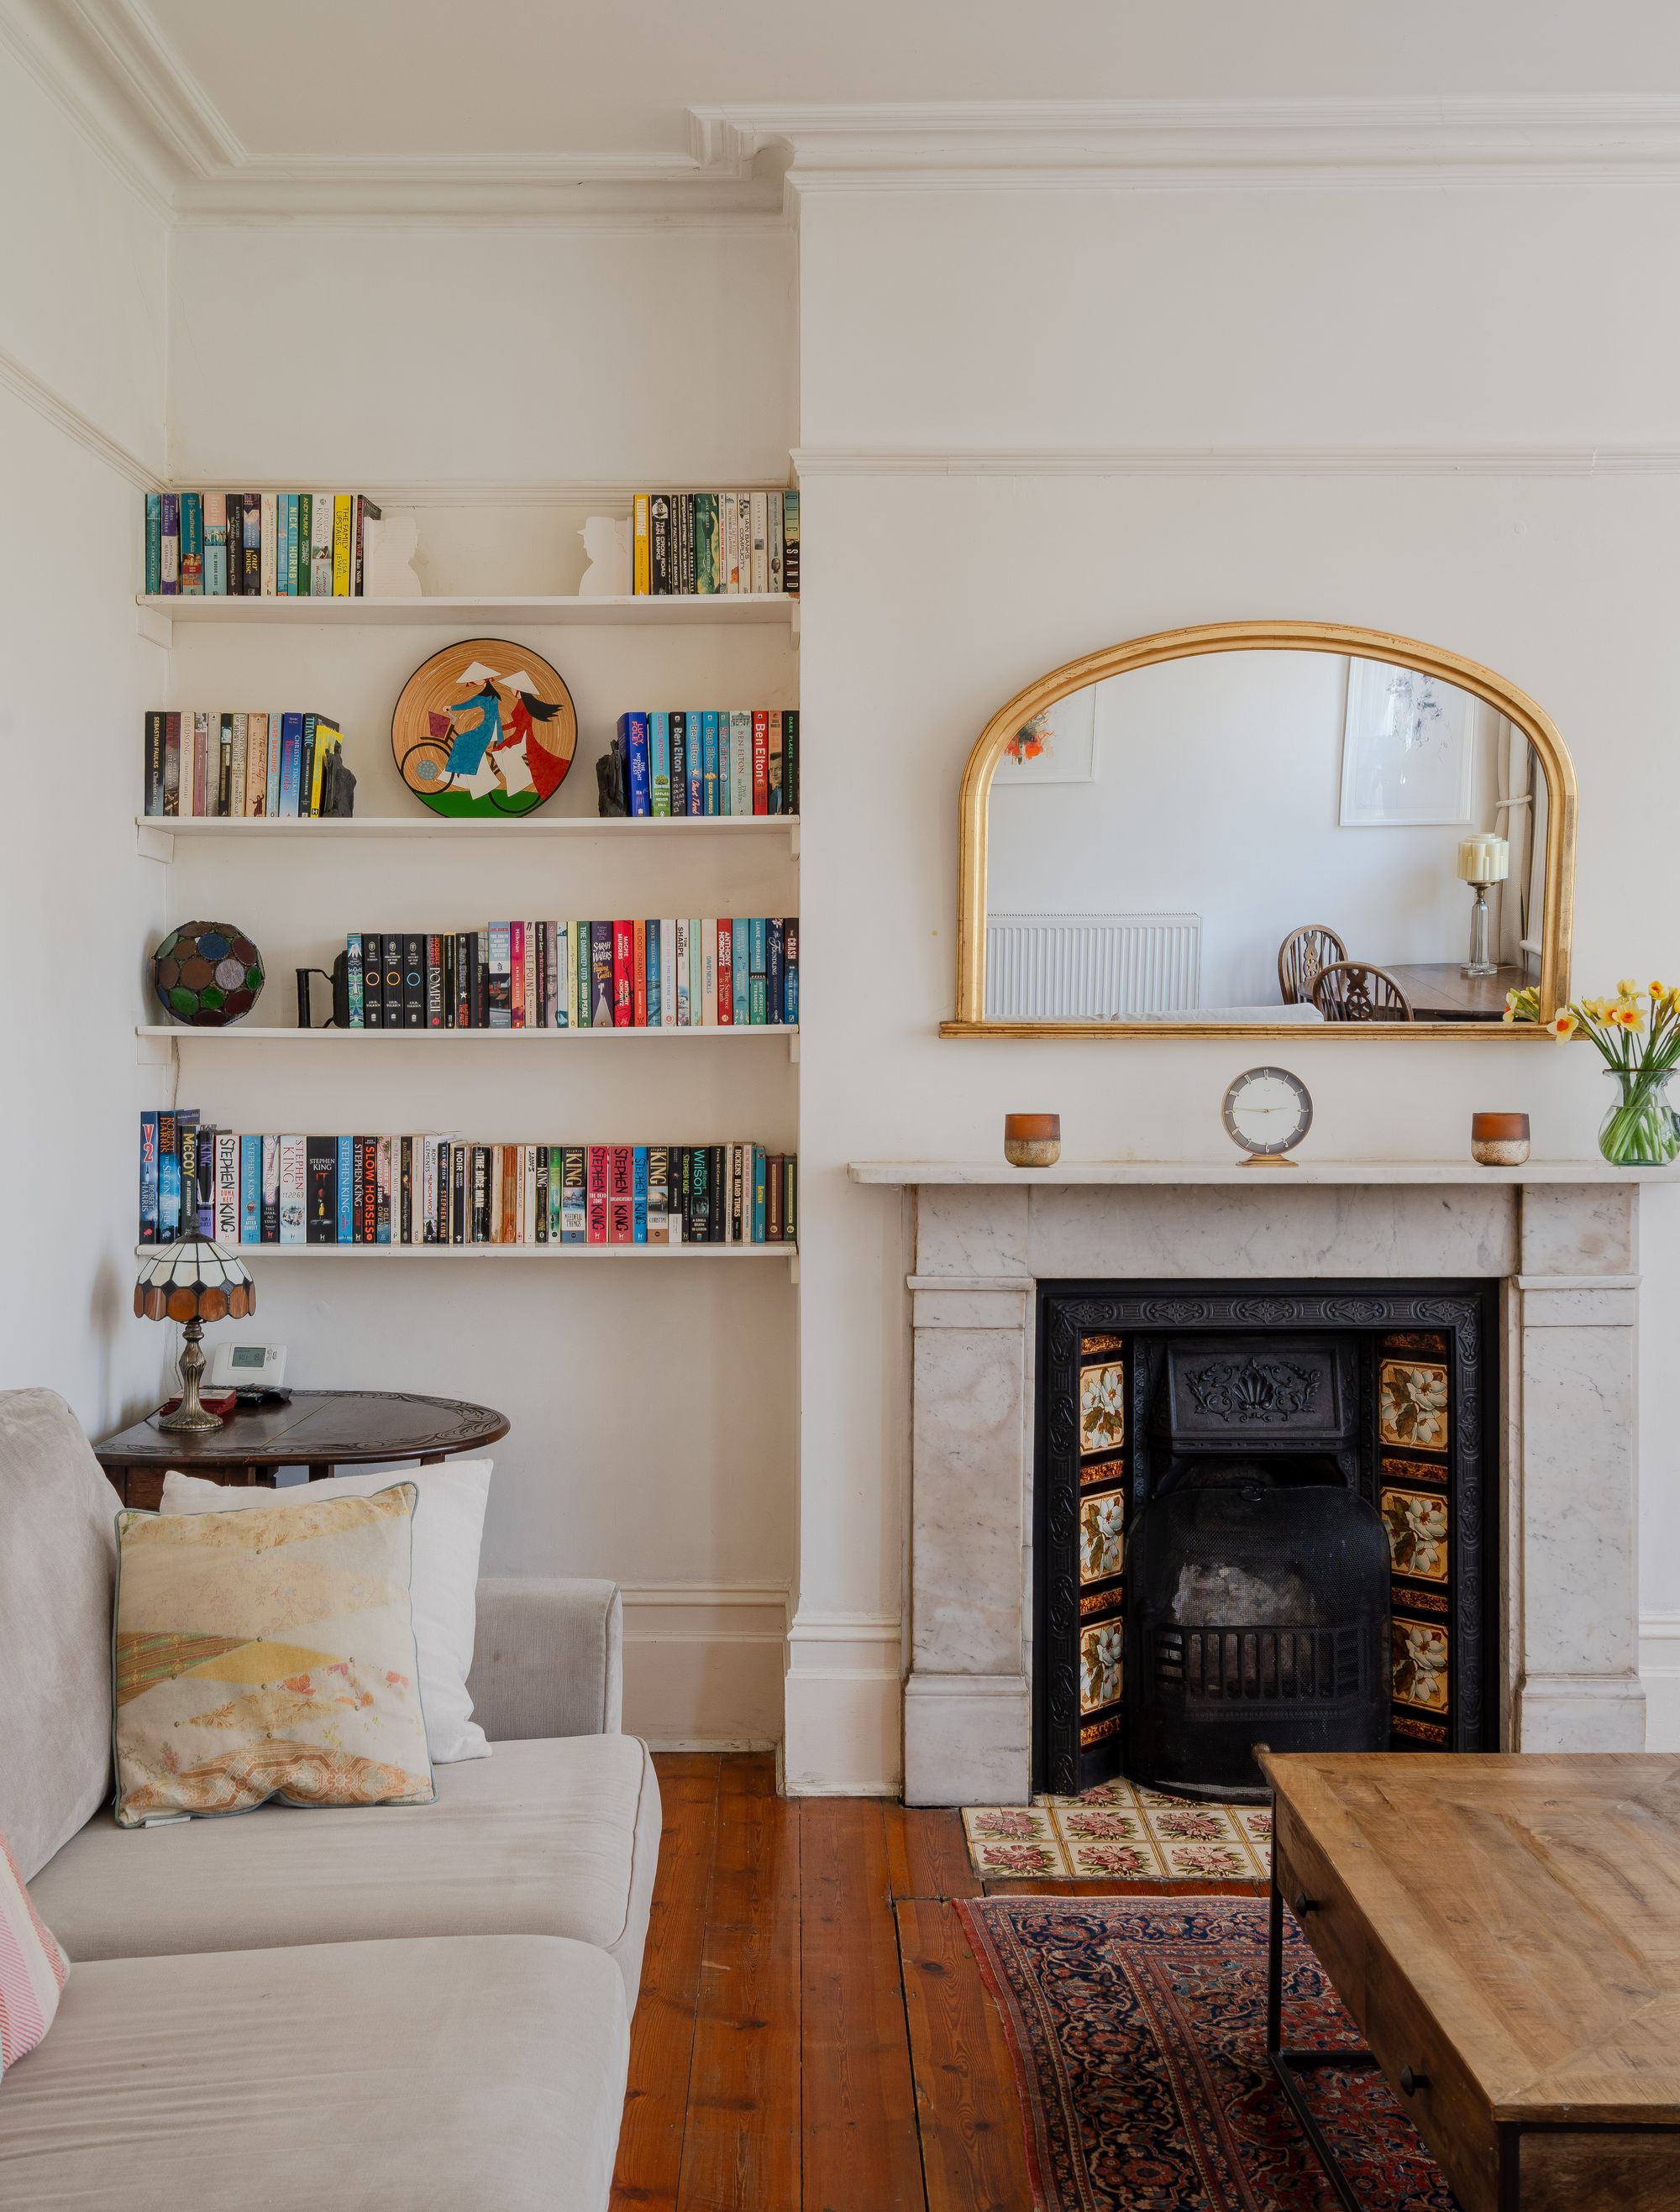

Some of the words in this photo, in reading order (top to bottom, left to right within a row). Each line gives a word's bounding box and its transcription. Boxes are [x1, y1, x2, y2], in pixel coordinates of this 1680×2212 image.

[289, 507, 297, 529] NICK
[246, 550, 255, 575] house
[289, 546, 297, 585] HORNBY
[304, 717, 315, 747] TITANIC
[674, 727, 682, 745] Ben
[690, 726, 699, 742] Ben
[706, 727, 714, 745] Ben
[756, 723, 766, 745] Ben
[284, 740, 294, 791] Barracuda
[674, 747, 683, 772] Elton
[690, 743, 699, 766] Elton
[706, 747, 715, 772] Elton
[756, 748, 766, 777] Elton
[525, 935, 534, 963] BULLET
[593, 941, 611, 952] SARAH
[593, 951, 612, 962] WATERS
[788, 938, 796, 959] CRASH
[429, 967, 441, 1011] POMPEII
[525, 967, 534, 996] POINTS
[200, 1144, 212, 1166] KING
[220, 1138, 235, 1189] STEPHEN
[283, 1147, 295, 1182] KING
[295, 1140, 304, 1190] STEPHEN
[341, 1140, 350, 1184] STEPHEN
[365, 1146, 375, 1180] SLOW
[476, 1154, 484, 1168] THE
[315, 1172, 329, 1186] IT
[475, 1171, 484, 1187] DICE
[537, 1168, 547, 1187] KING
[566, 1153, 582, 1185] KING
[591, 1147, 605, 1192] STEPHEN
[614, 1148, 628, 1193] STEPHEN
[635, 1158, 646, 1194] STEPHEN
[650, 1152, 667, 1184] KING
[693, 1150, 705, 1195] Wilson
[266, 1182, 275, 1204] KING
[341, 1187, 350, 1212] KING
[354, 1185, 363, 1206] KING
[475, 1190, 484, 1208] MAN
[220, 1203, 235, 1232] KING
[365, 1185, 375, 1233] HORSES
[591, 1203, 605, 1230] KING
[614, 1205, 629, 1231] KING
[635, 1203, 646, 1225] KING
